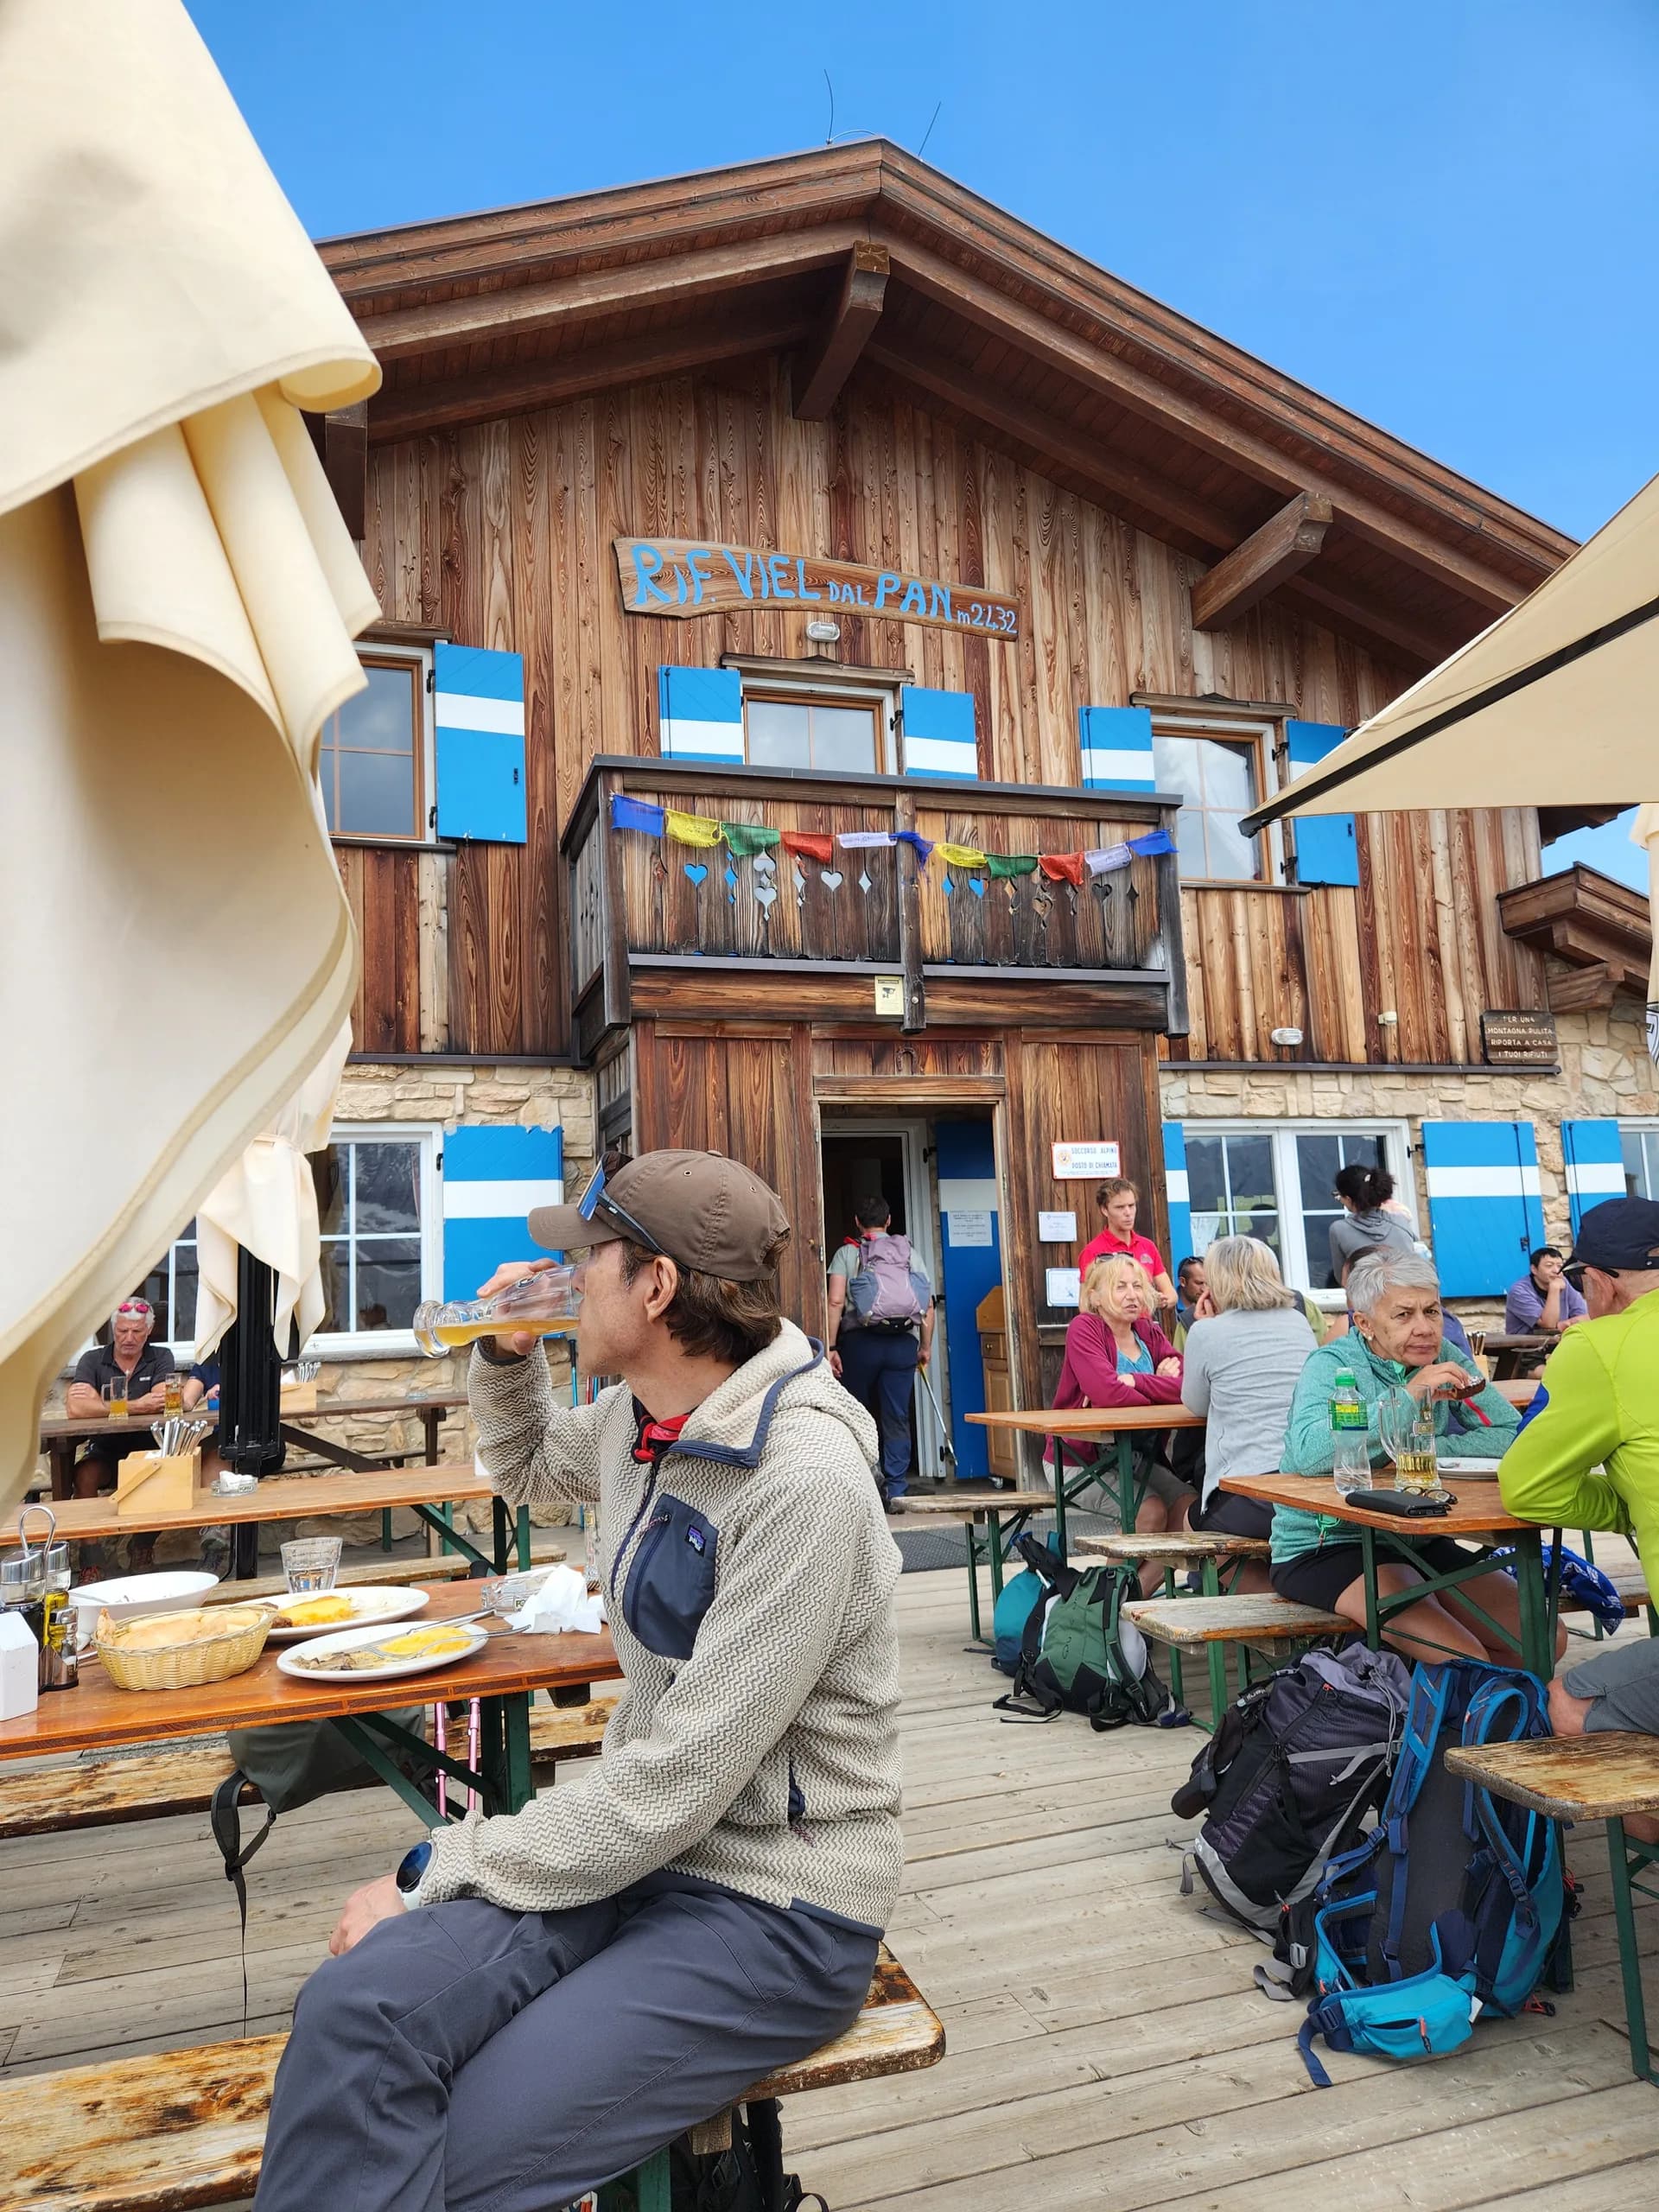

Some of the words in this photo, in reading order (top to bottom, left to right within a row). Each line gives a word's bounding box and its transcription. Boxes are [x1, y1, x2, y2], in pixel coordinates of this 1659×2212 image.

[721, 550, 820, 600] VIEL
[826, 582, 869, 606] DAL
[874, 573, 952, 622] PAN
